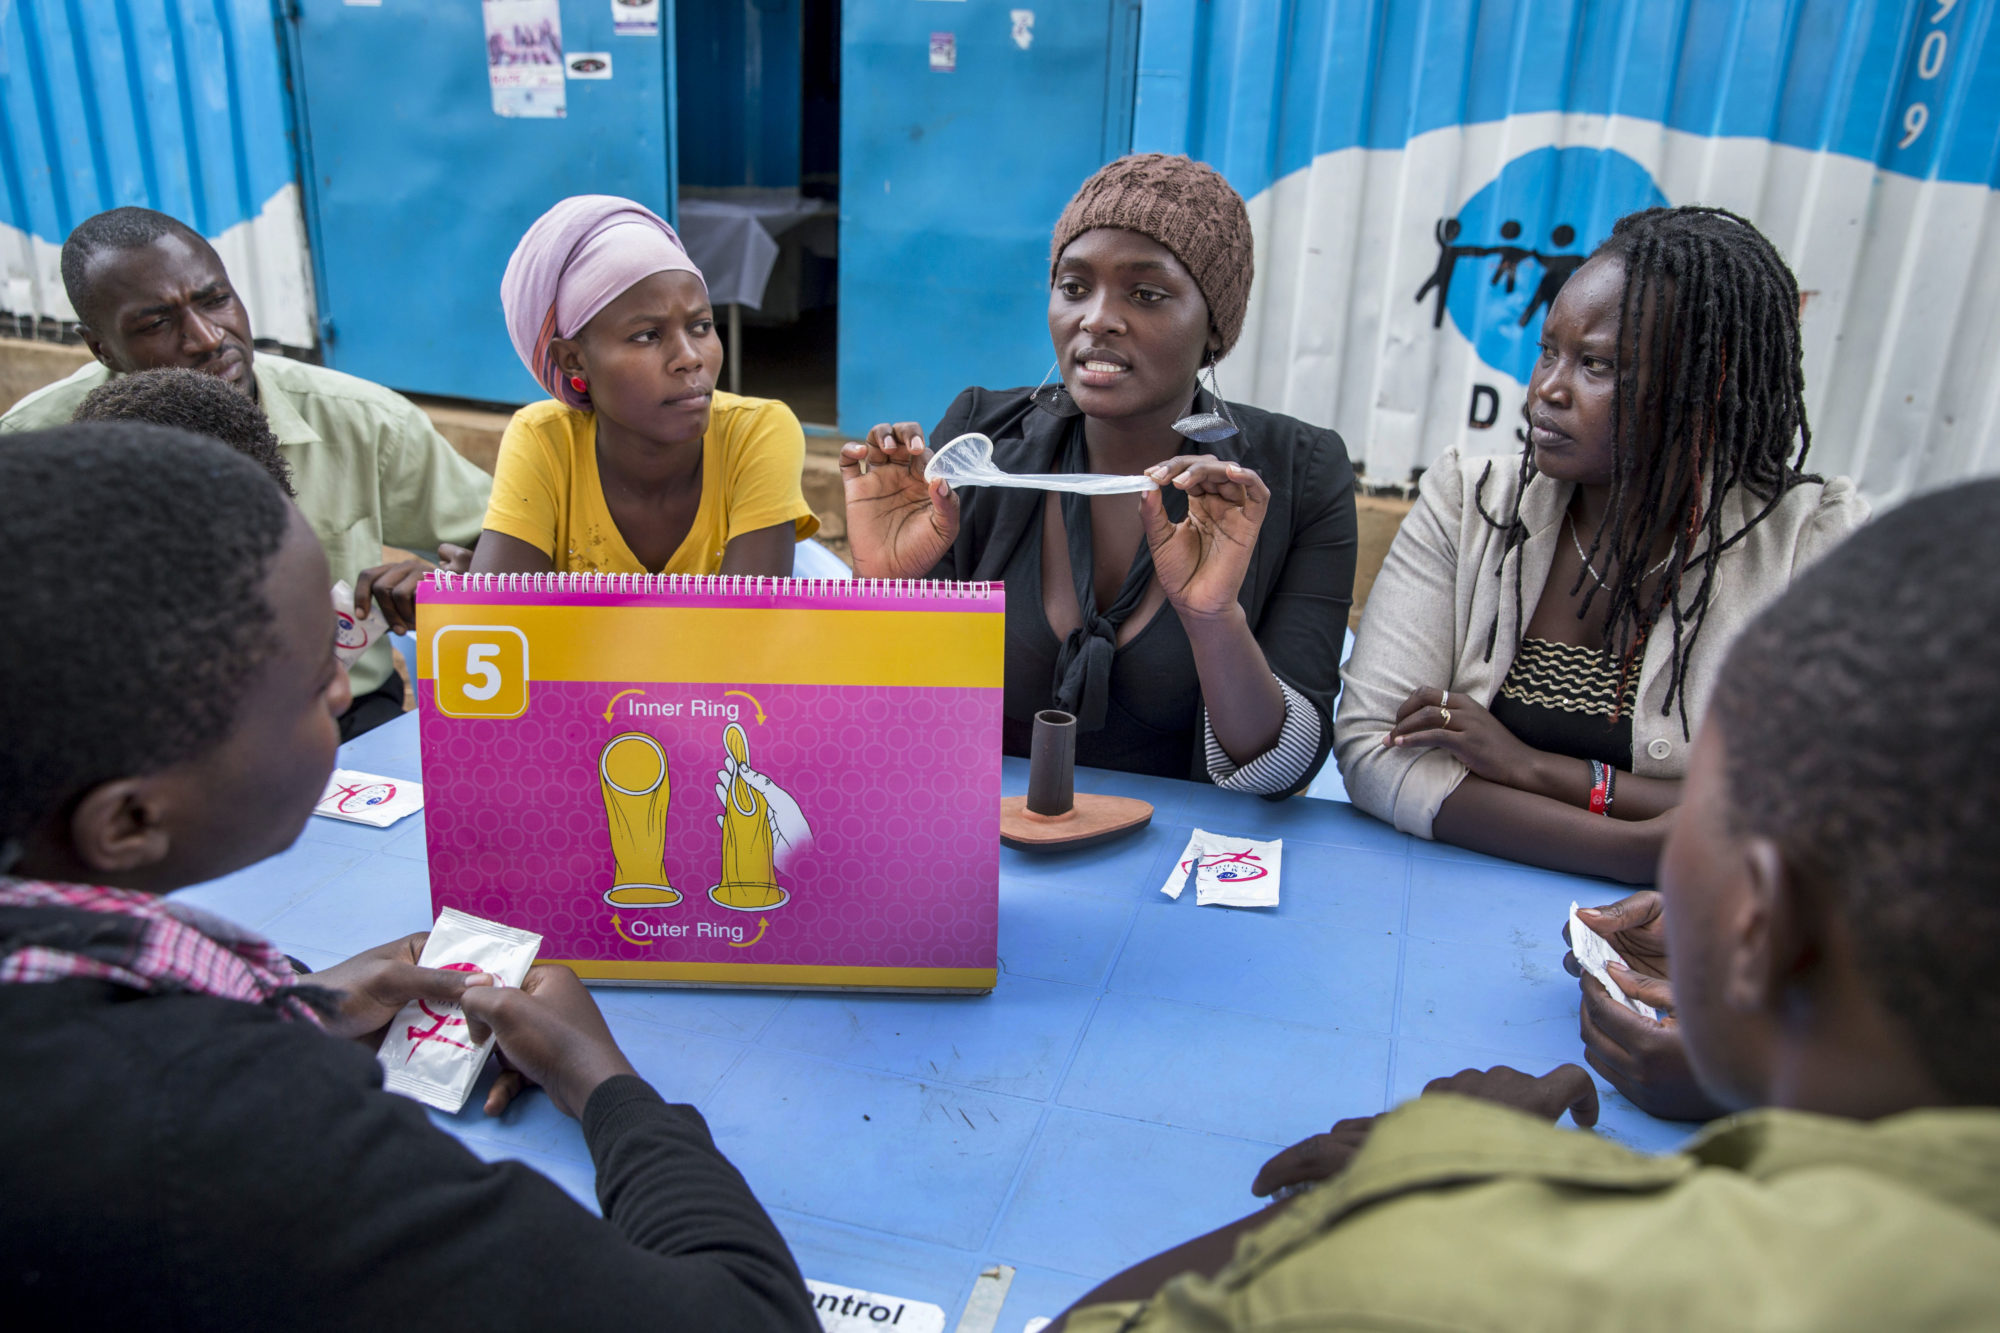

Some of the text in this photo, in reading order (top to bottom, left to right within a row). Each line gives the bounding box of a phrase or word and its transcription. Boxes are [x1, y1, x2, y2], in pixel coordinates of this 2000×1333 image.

[462, 643, 502, 701] 5
[629, 699, 740, 721] Inner Ring
[631, 921, 744, 943] Outer Ring
[807, 1291, 905, 1325] ntrol
